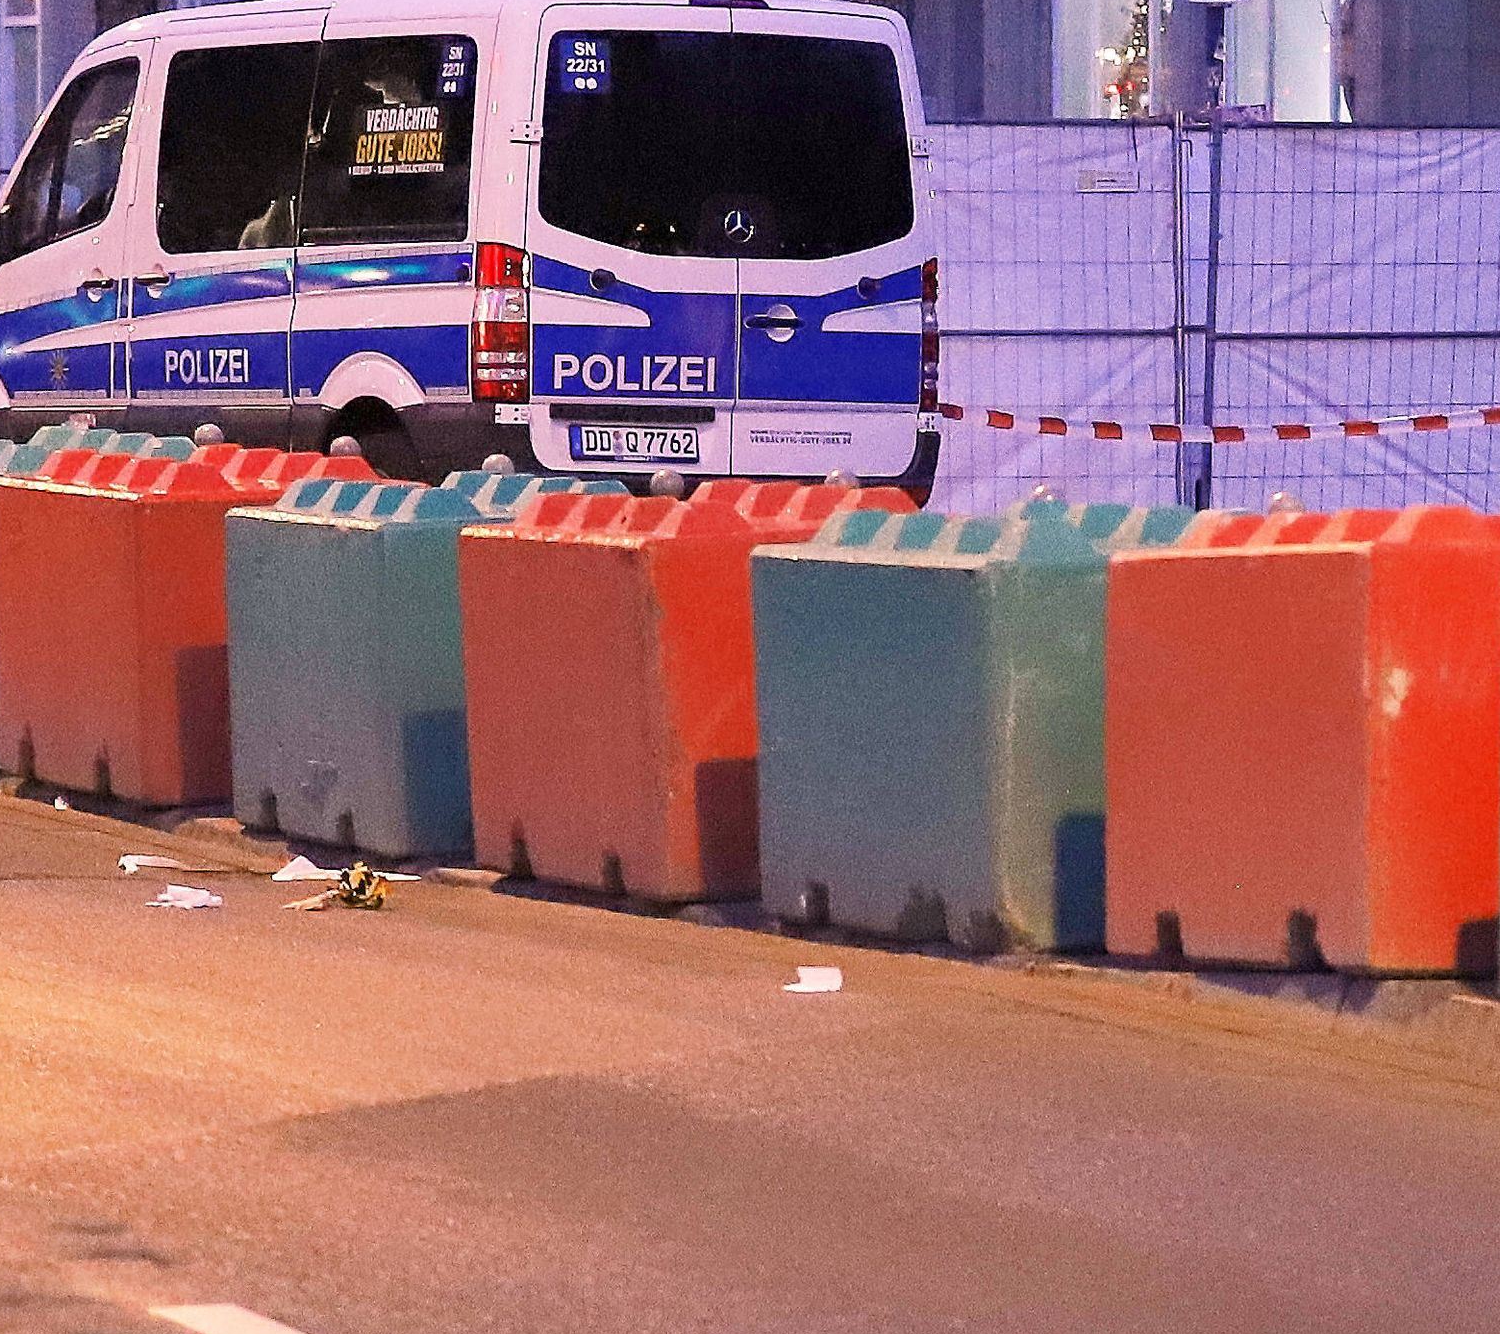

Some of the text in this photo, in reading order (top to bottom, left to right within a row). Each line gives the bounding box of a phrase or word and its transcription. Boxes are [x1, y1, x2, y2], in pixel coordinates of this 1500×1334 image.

[574, 42, 596, 56] SN
[566, 59, 605, 73] 22/31
[366, 103, 440, 132] VERDÄCHTIG
[356, 131, 443, 163] GUTE JOBS!
[165, 348, 249, 384] POLIZEI
[553, 354, 716, 392] POLIZEI
[585, 429, 695, 454] DD Q 7762
